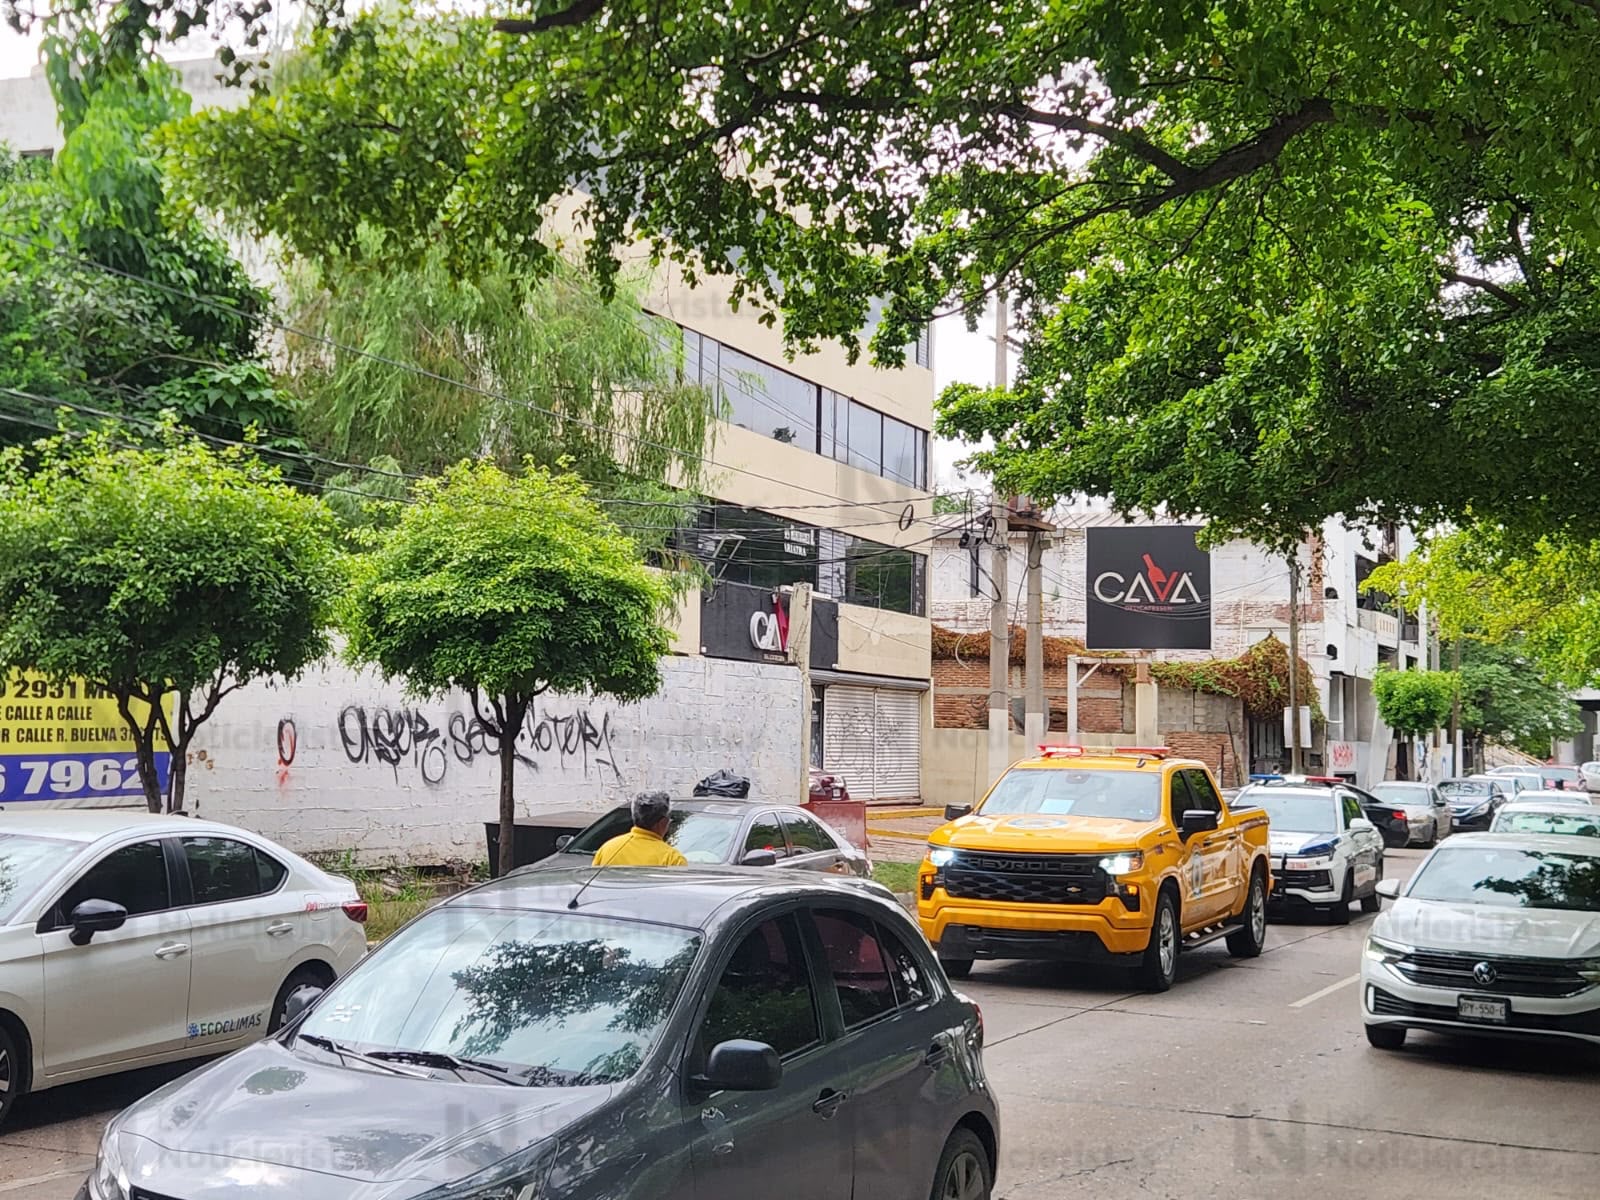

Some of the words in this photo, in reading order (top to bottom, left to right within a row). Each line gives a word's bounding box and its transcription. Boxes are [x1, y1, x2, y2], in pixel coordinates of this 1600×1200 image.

[1094, 560, 1201, 603] CAVA
[5, 705, 43, 721] CALLE
[46, 706, 54, 721] A
[57, 706, 93, 721] CALLE
[16, 728, 54, 743] CALLE
[56, 728, 68, 743] R.
[71, 727, 117, 742] BUELNA
[20, 758, 144, 795] 7962
[200, 1013, 263, 1037] ECOCLIMAS
